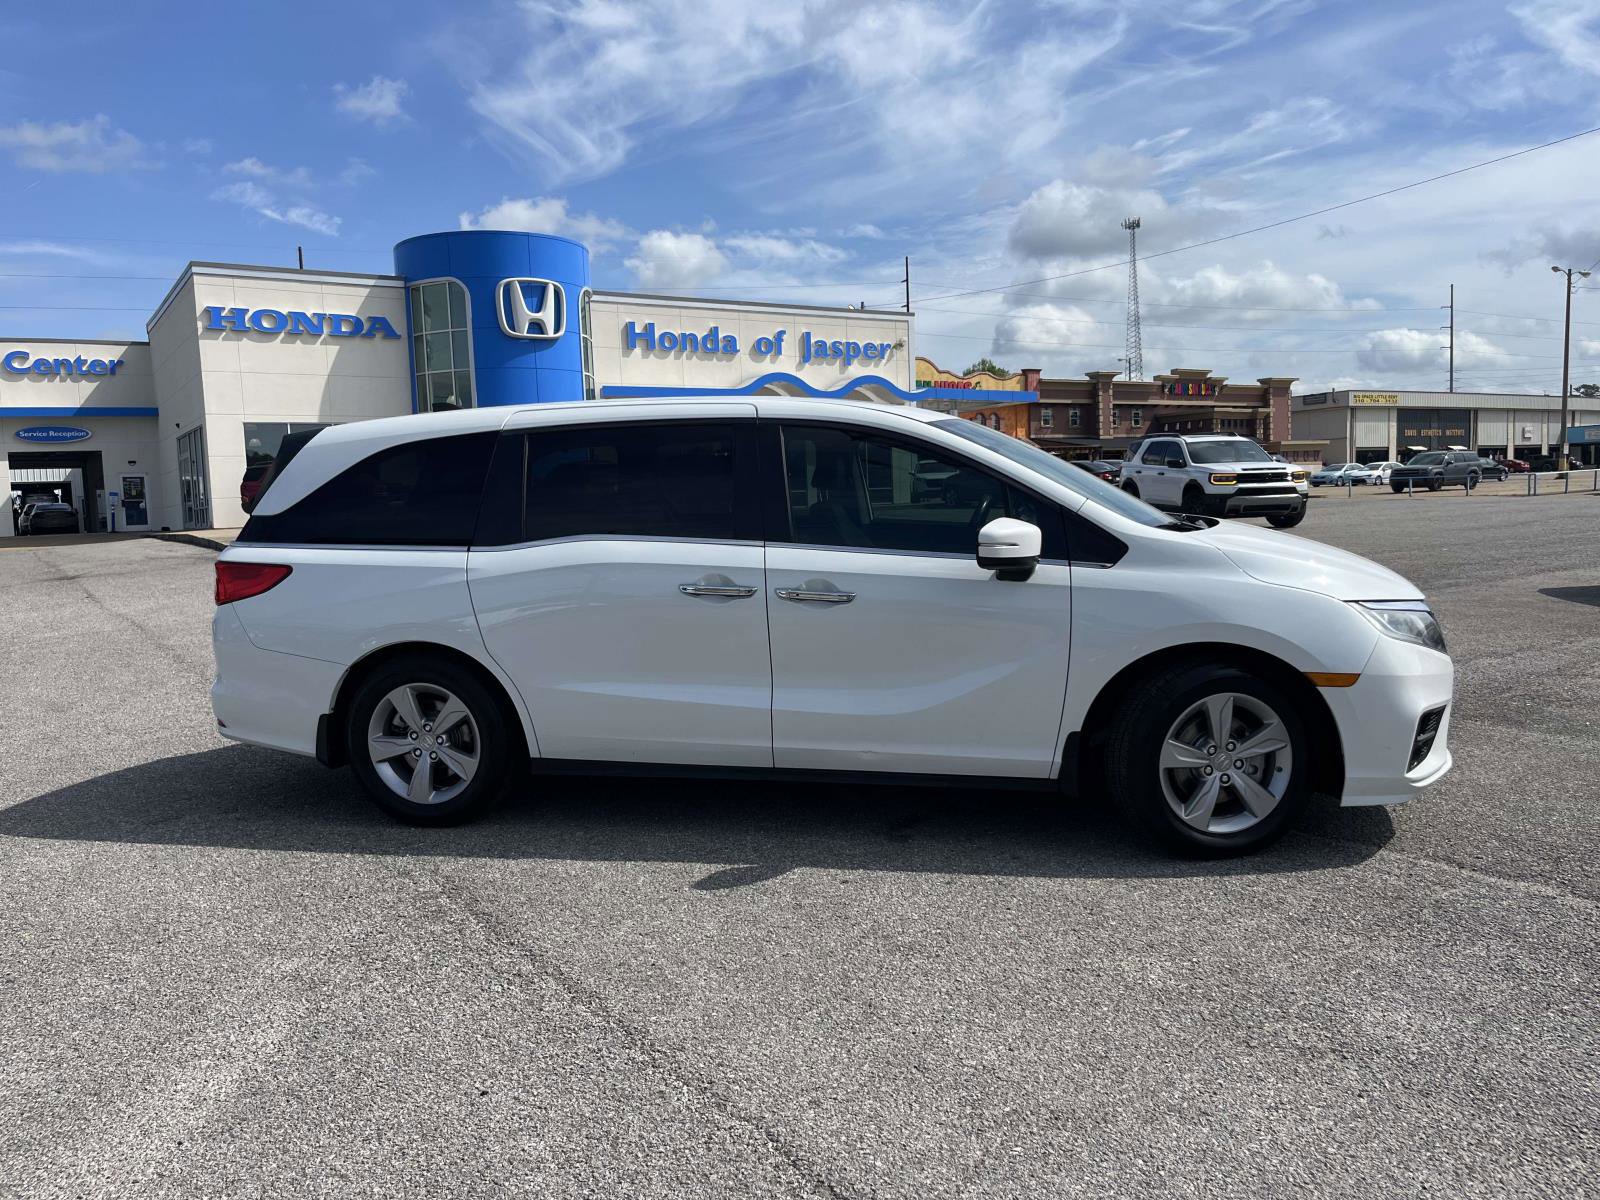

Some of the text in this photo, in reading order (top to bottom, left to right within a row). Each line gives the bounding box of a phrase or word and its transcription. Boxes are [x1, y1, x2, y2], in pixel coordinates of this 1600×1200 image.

[205, 305, 401, 339] HONDA
[625, 321, 893, 366] Honda of Jasper
[3, 350, 125, 376] Center
[49, 430, 87, 438] Reception
